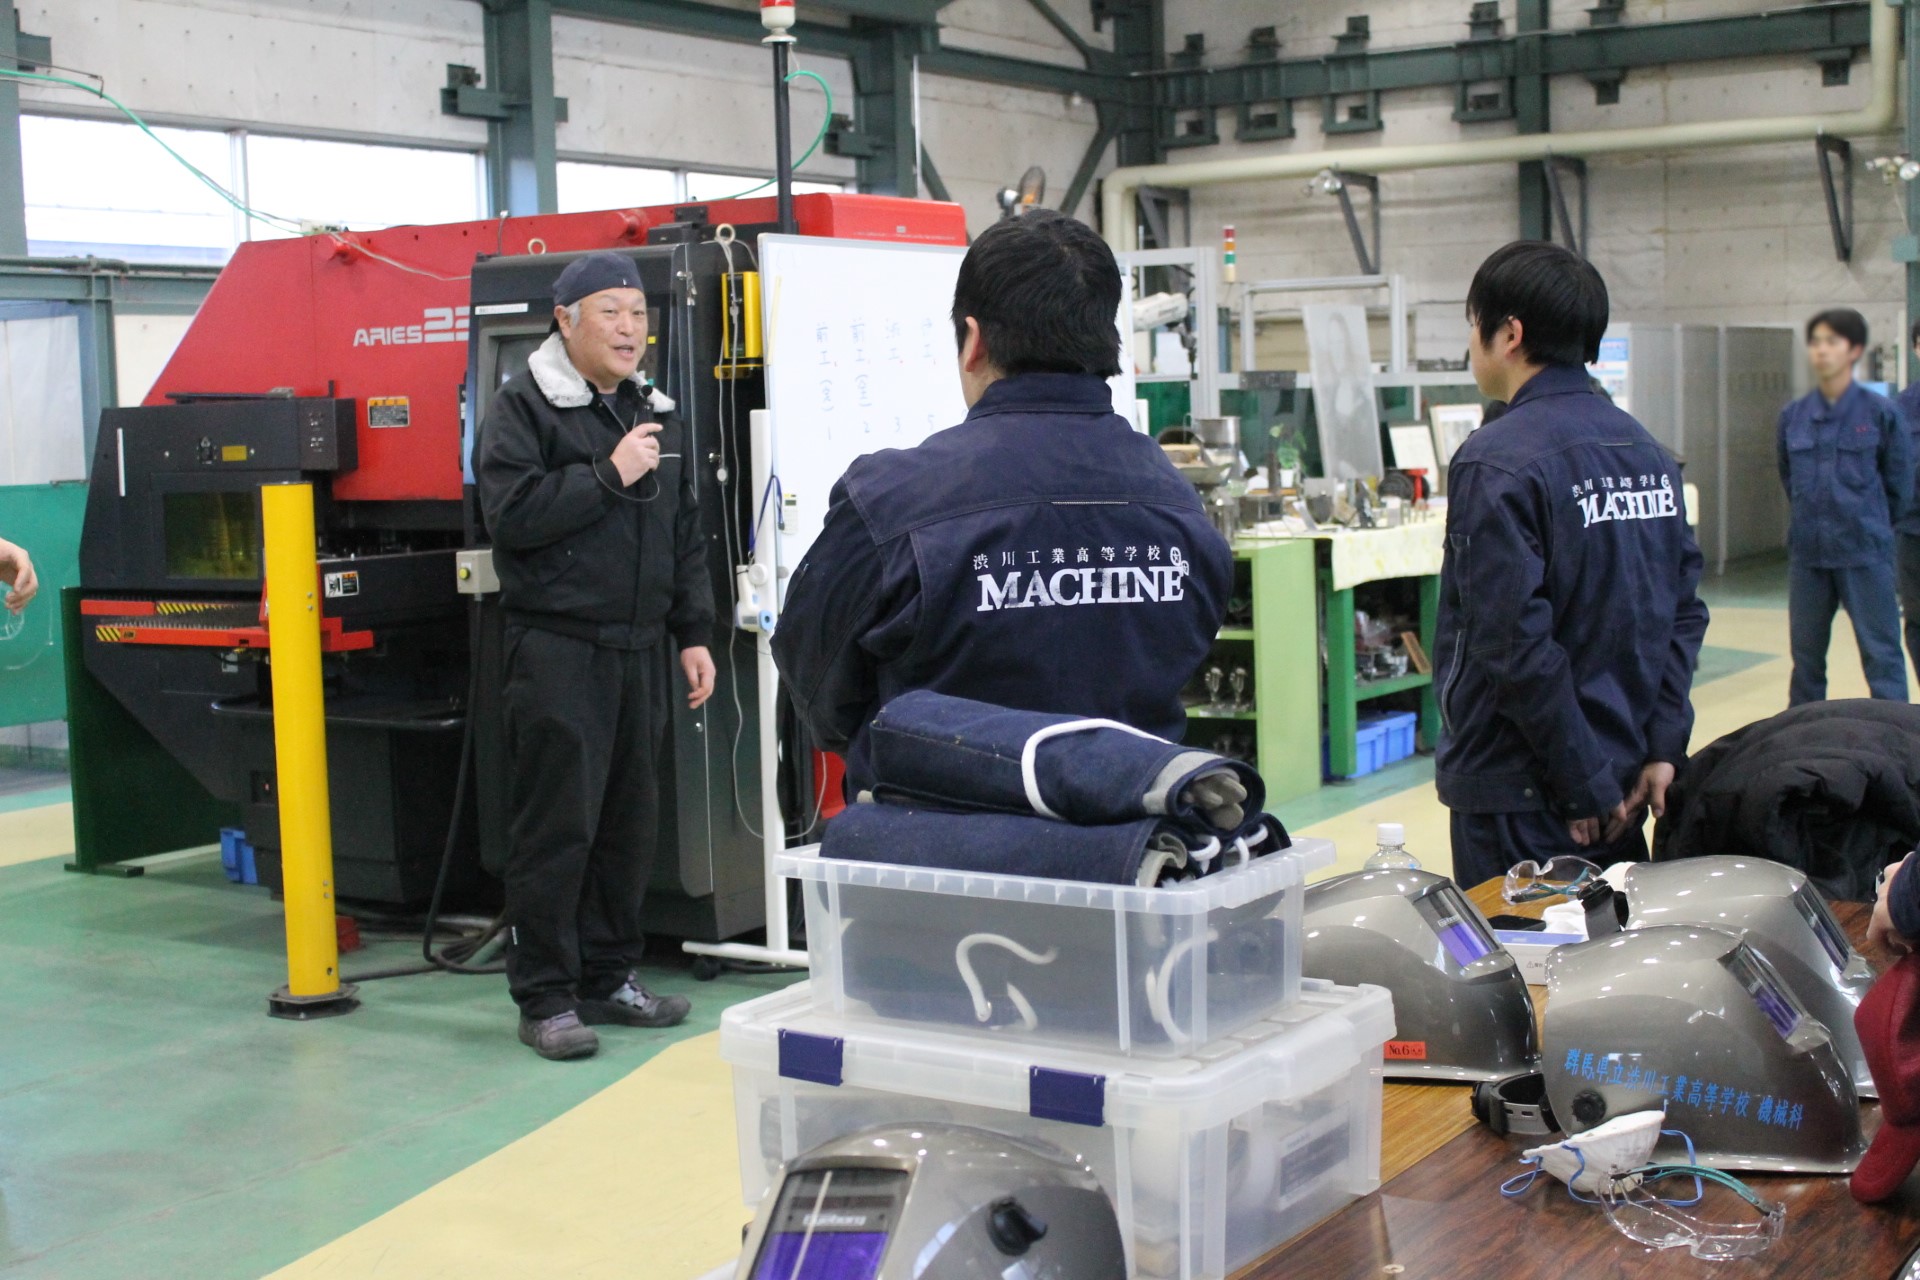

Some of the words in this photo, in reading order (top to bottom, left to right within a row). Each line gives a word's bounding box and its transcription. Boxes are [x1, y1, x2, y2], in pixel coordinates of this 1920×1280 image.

[353, 325, 422, 347] ARIES
[973, 545, 1161, 570] 渋川工業高等学校
[976, 565, 1185, 612] MACHINE
[1564, 1048, 1749, 1118] 群馬県立渋川工業高等学校
[1757, 1096, 1804, 1131] 機械科
